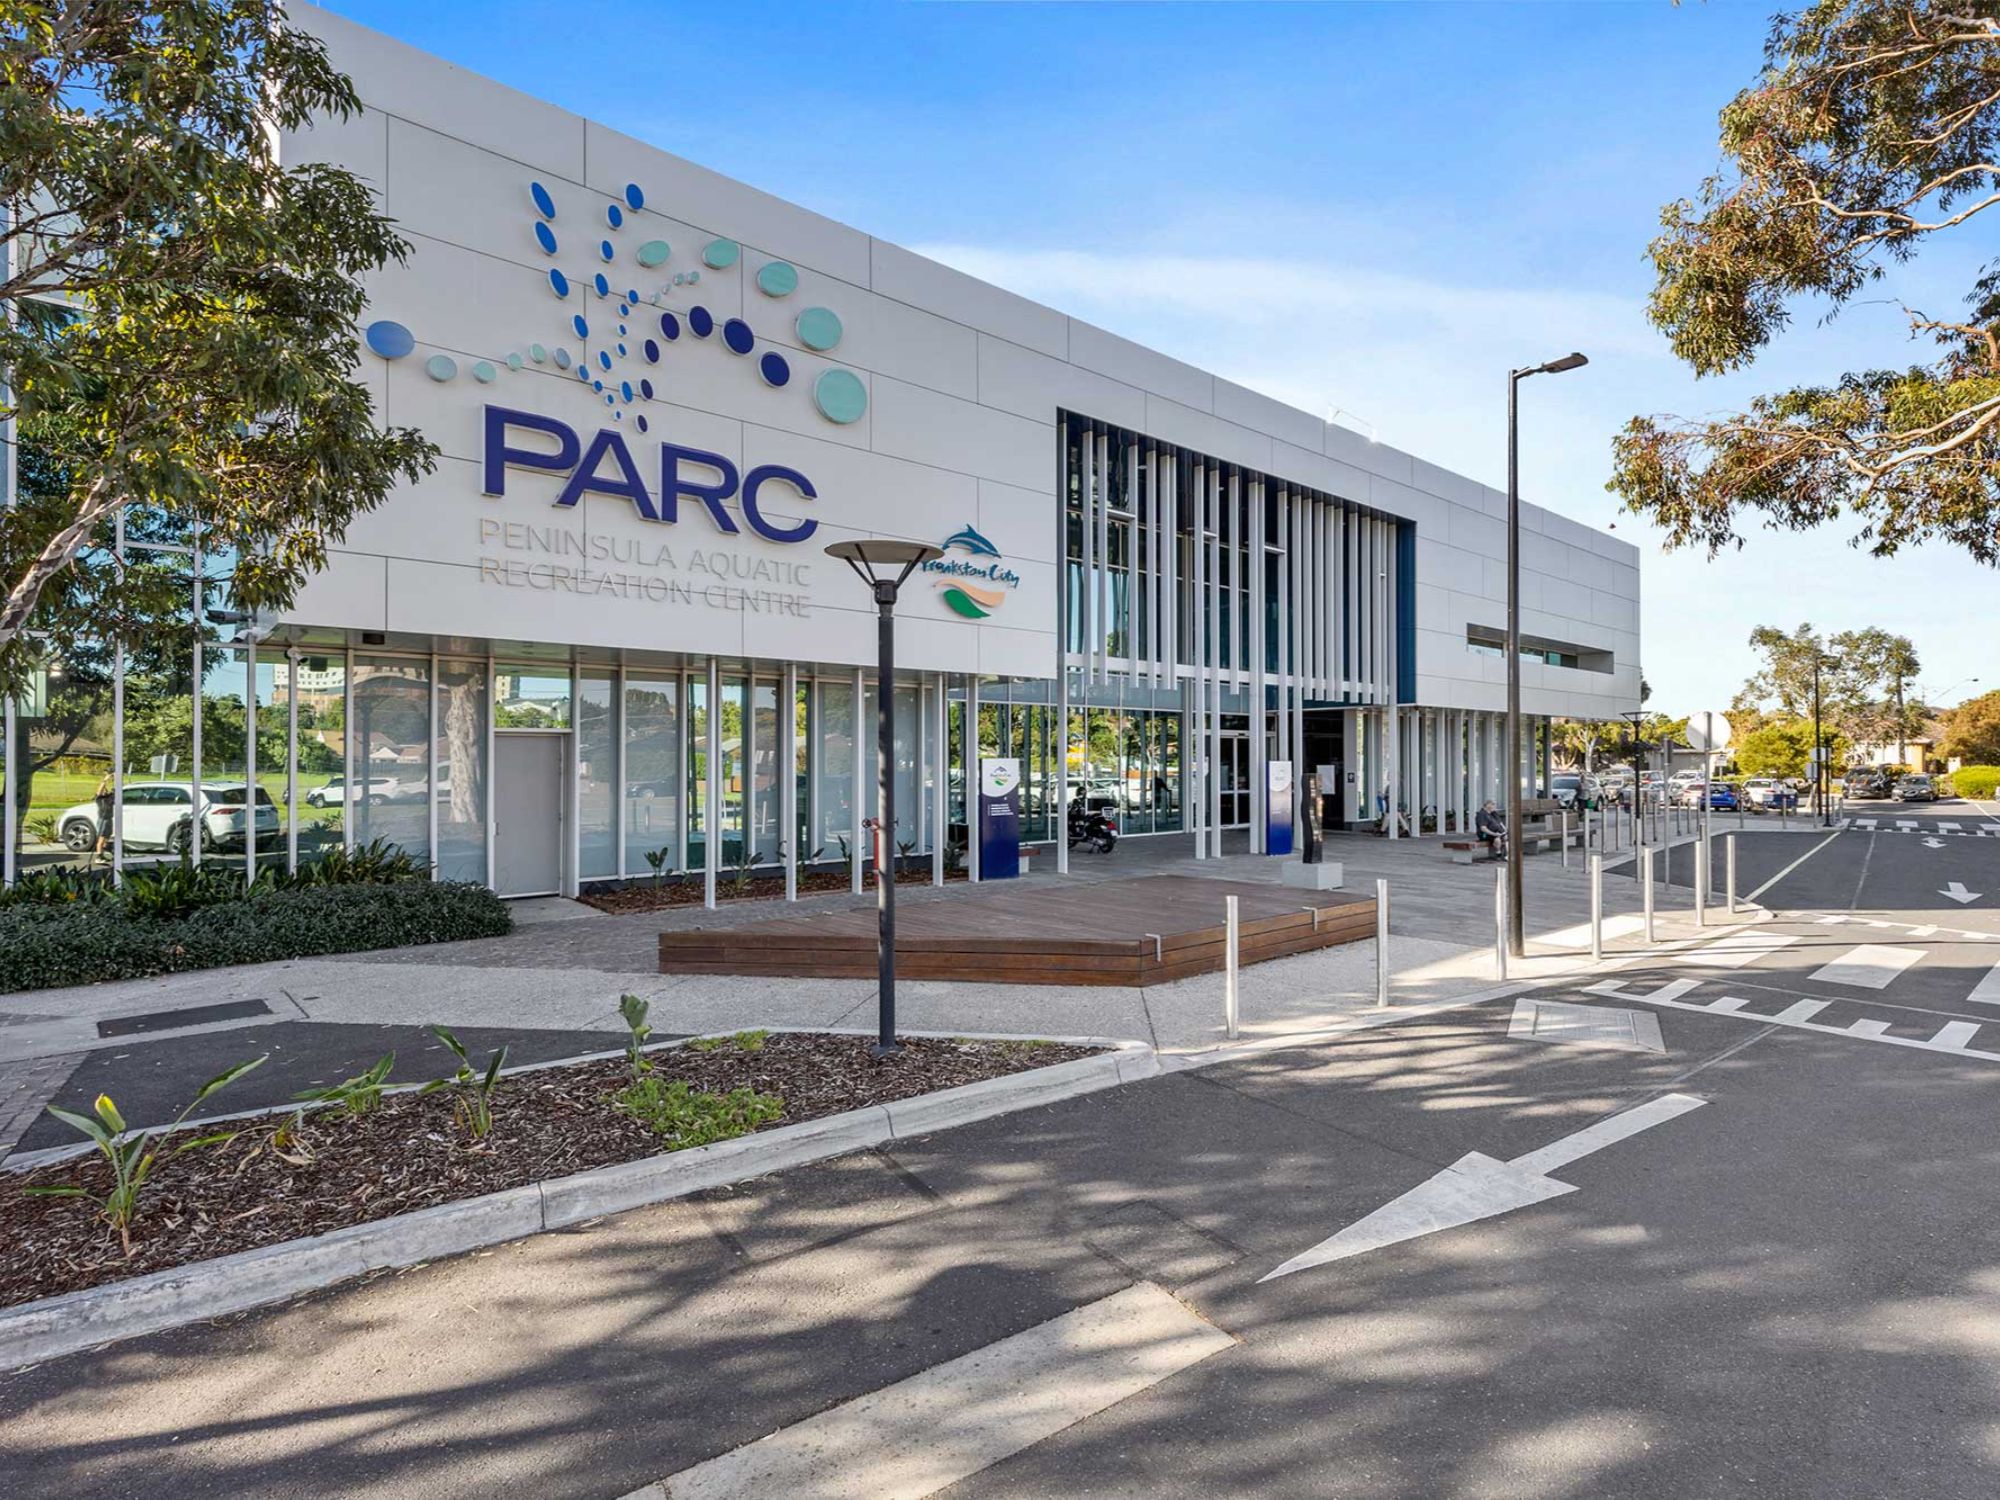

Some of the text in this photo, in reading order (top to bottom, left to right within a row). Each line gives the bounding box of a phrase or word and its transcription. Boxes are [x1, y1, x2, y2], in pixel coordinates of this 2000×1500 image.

[481, 403, 818, 543] PARC
[479, 518, 811, 587] PENINSULA AQUATIC
[988, 564, 1020, 589] City
[479, 556, 811, 618] RECREATION CENTRE
